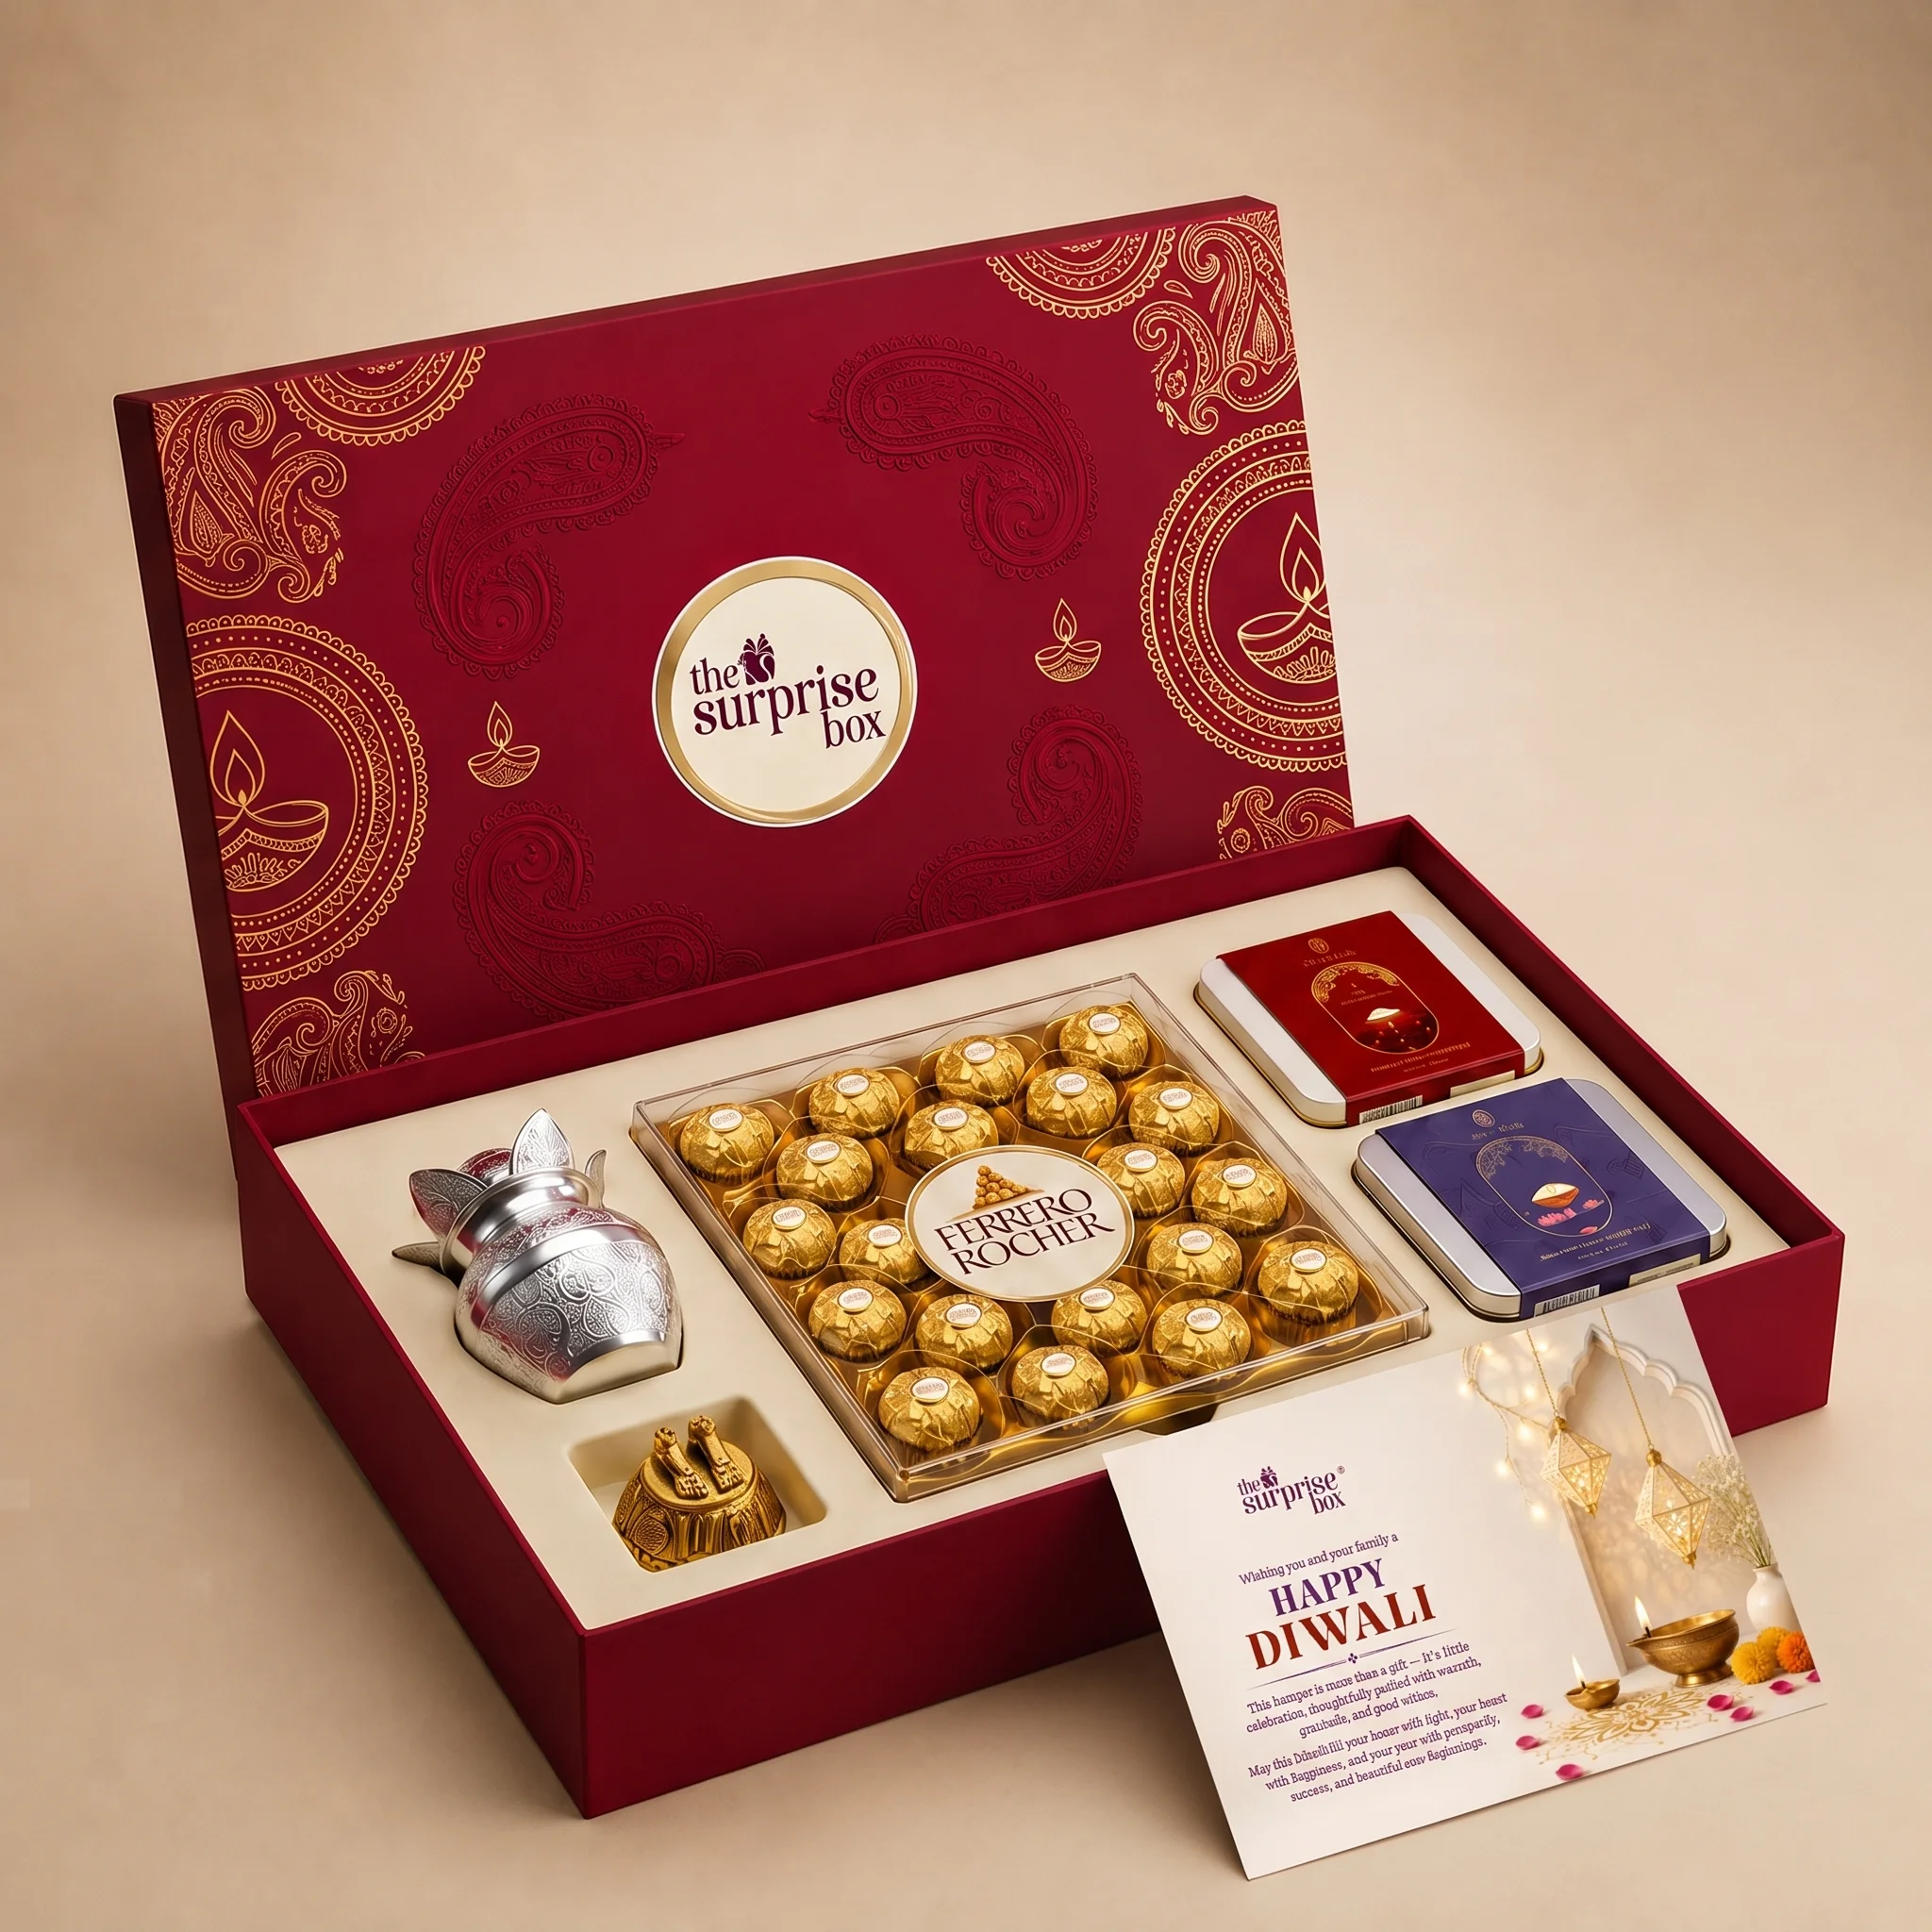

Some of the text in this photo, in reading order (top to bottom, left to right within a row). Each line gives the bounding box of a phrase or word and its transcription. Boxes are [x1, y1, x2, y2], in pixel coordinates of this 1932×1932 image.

[690, 657, 741, 695] the
[693, 664, 879, 736] surprise
[820, 710, 887, 749] box
[934, 1189, 1093, 1252] FERRERO
[951, 1212, 1116, 1274] ROCHER
[1237, 1478, 1261, 1496] the
[1308, 1491, 1346, 1515] box
[1285, 1559, 1307, 1574] you
[1307, 1550, 1329, 1566] and
[1328, 1545, 1354, 1563] your
[1354, 1534, 1391, 1553] family
[1391, 1533, 1399, 1542] a
[1268, 1557, 1385, 1617] HAPPY
[1245, 1584, 1436, 1670] DIWALI
[1247, 1699, 1273, 1714] This
[1272, 1688, 1314, 1707] hamper
[1314, 1684, 1324, 1695] is
[1354, 1668, 1381, 1683] than
[1380, 1667, 1388, 1675] a
[1389, 1658, 1408, 1675] gift
[1308, 1688, 1373, 1715] thoughtfully
[1411, 1669, 1436, 1685] with
[1351, 1705, 1374, 1721] and
[1373, 1697, 1400, 1717] good
[1248, 1763, 1272, 1777] May
[1272, 1756, 1293, 1770] this
[1344, 1735, 1369, 1751] your
[1400, 1717, 1424, 1733] with
[1453, 1704, 1477, 1720] your
[1347, 1751, 1370, 1767] and
[1369, 1746, 1393, 1763] your
[1419, 1729, 1443, 1745] with
[1291, 1783, 1333, 1803] success,
[1334, 1773, 1356, 1789] and
[1355, 1760, 1404, 1783] beautiful
